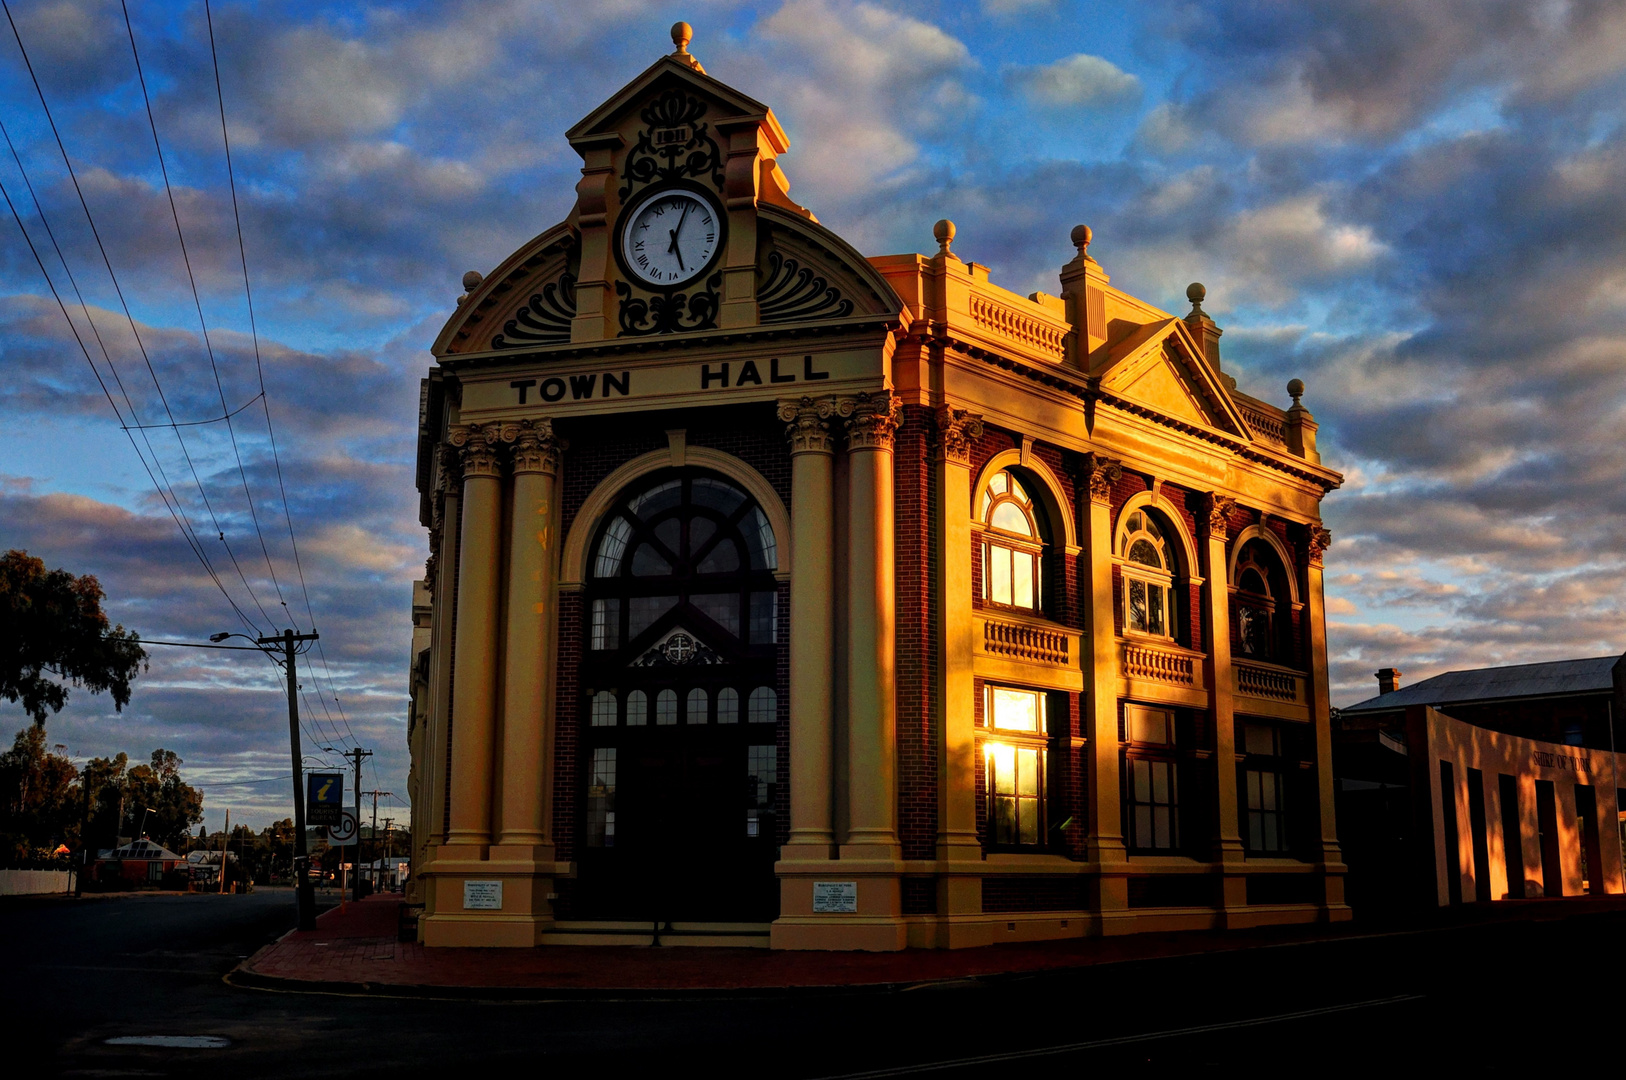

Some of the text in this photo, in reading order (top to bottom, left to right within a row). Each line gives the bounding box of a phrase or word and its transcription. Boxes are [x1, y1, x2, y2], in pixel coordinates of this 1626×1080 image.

[670, 201, 684, 210] XII
[652, 206, 665, 218] XI
[639, 222, 650, 231] X
[701, 216, 712, 225] II
[706, 233, 715, 243] III
[635, 240, 645, 252] IX
[510, 355, 830, 405] TOWN HALL
[1533, 750, 1592, 773] SHIRE OF YORK
[333, 820, 352, 833] 50
